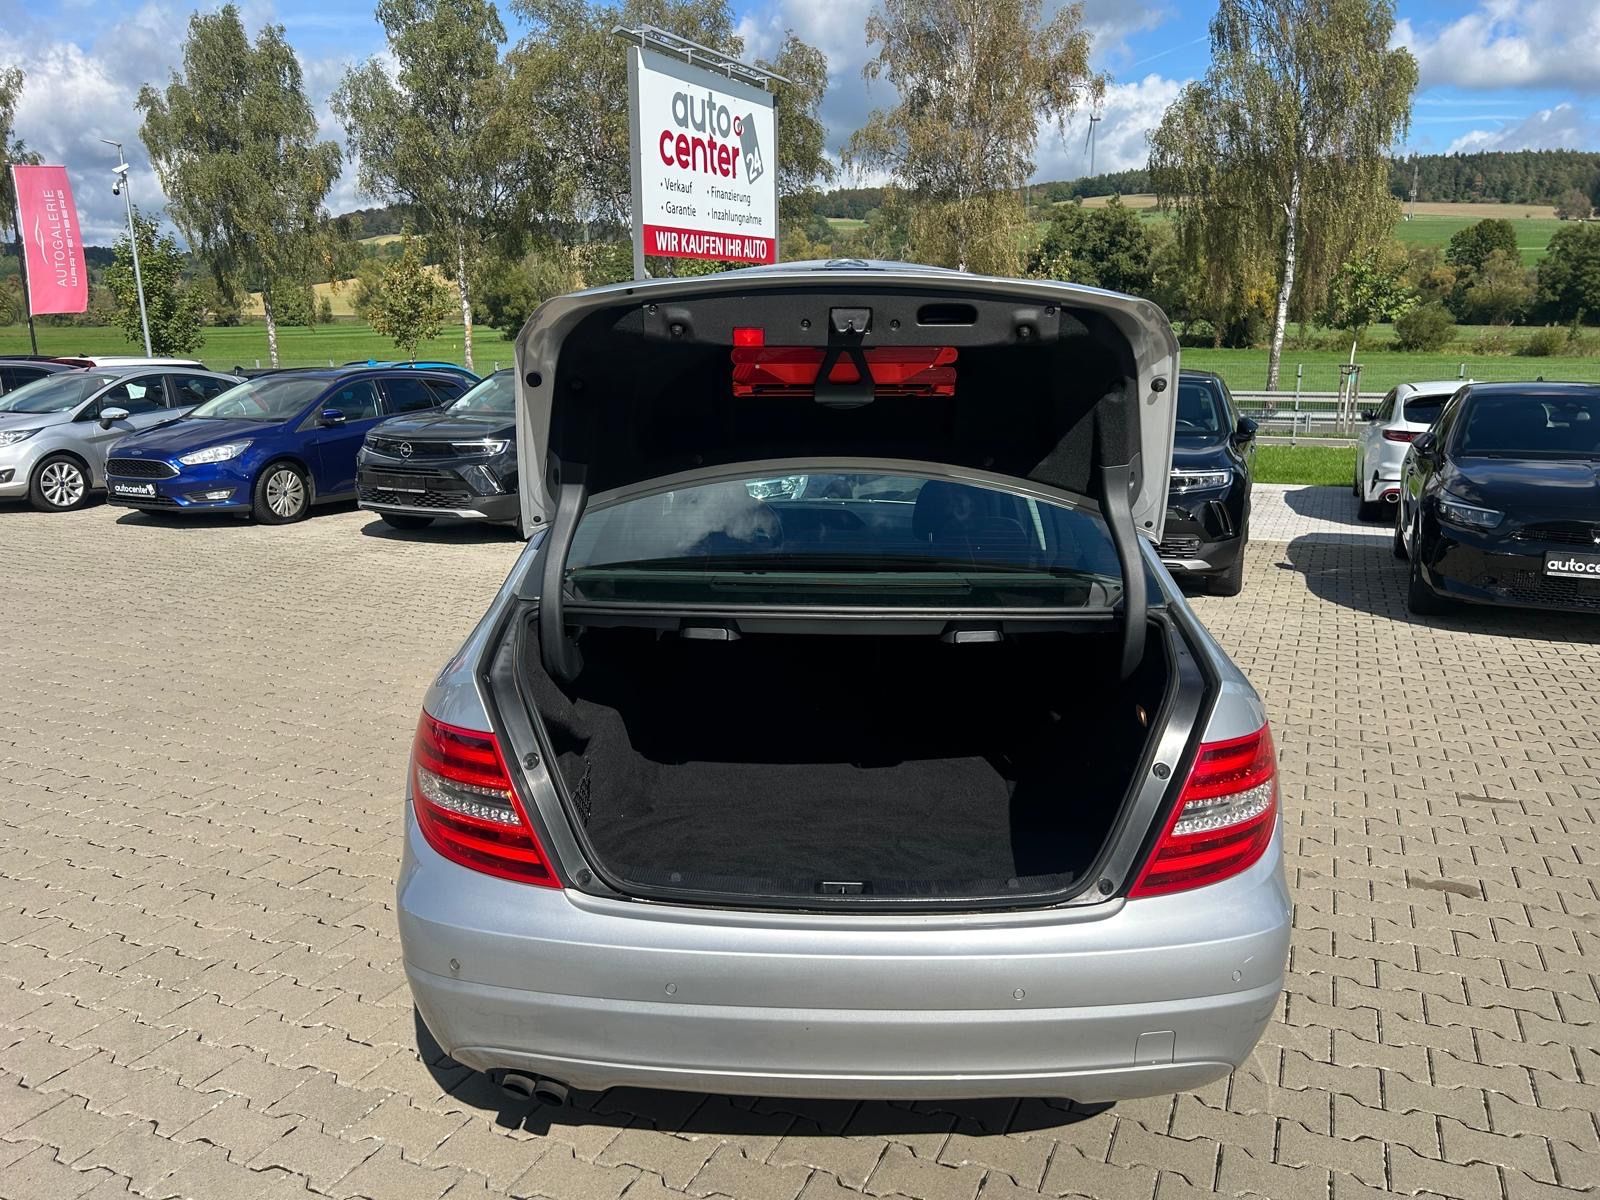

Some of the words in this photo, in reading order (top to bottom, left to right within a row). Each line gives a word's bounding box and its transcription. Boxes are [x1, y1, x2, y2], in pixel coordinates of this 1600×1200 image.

[672, 91, 731, 138] auto
[659, 130, 740, 179] center
[746, 146, 763, 178] 24
[665, 178, 693, 195] Verkauf
[710, 186, 751, 207] Finanzierung
[665, 201, 697, 217] Garantie
[711, 208, 763, 226] Inzahlungnahme
[43, 189, 68, 288] AUTOGALERIE
[655, 230, 679, 252] WIR
[681, 233, 723, 256] KAUFEN
[725, 238, 742, 258] IHR
[743, 238, 767, 260] AUTO
